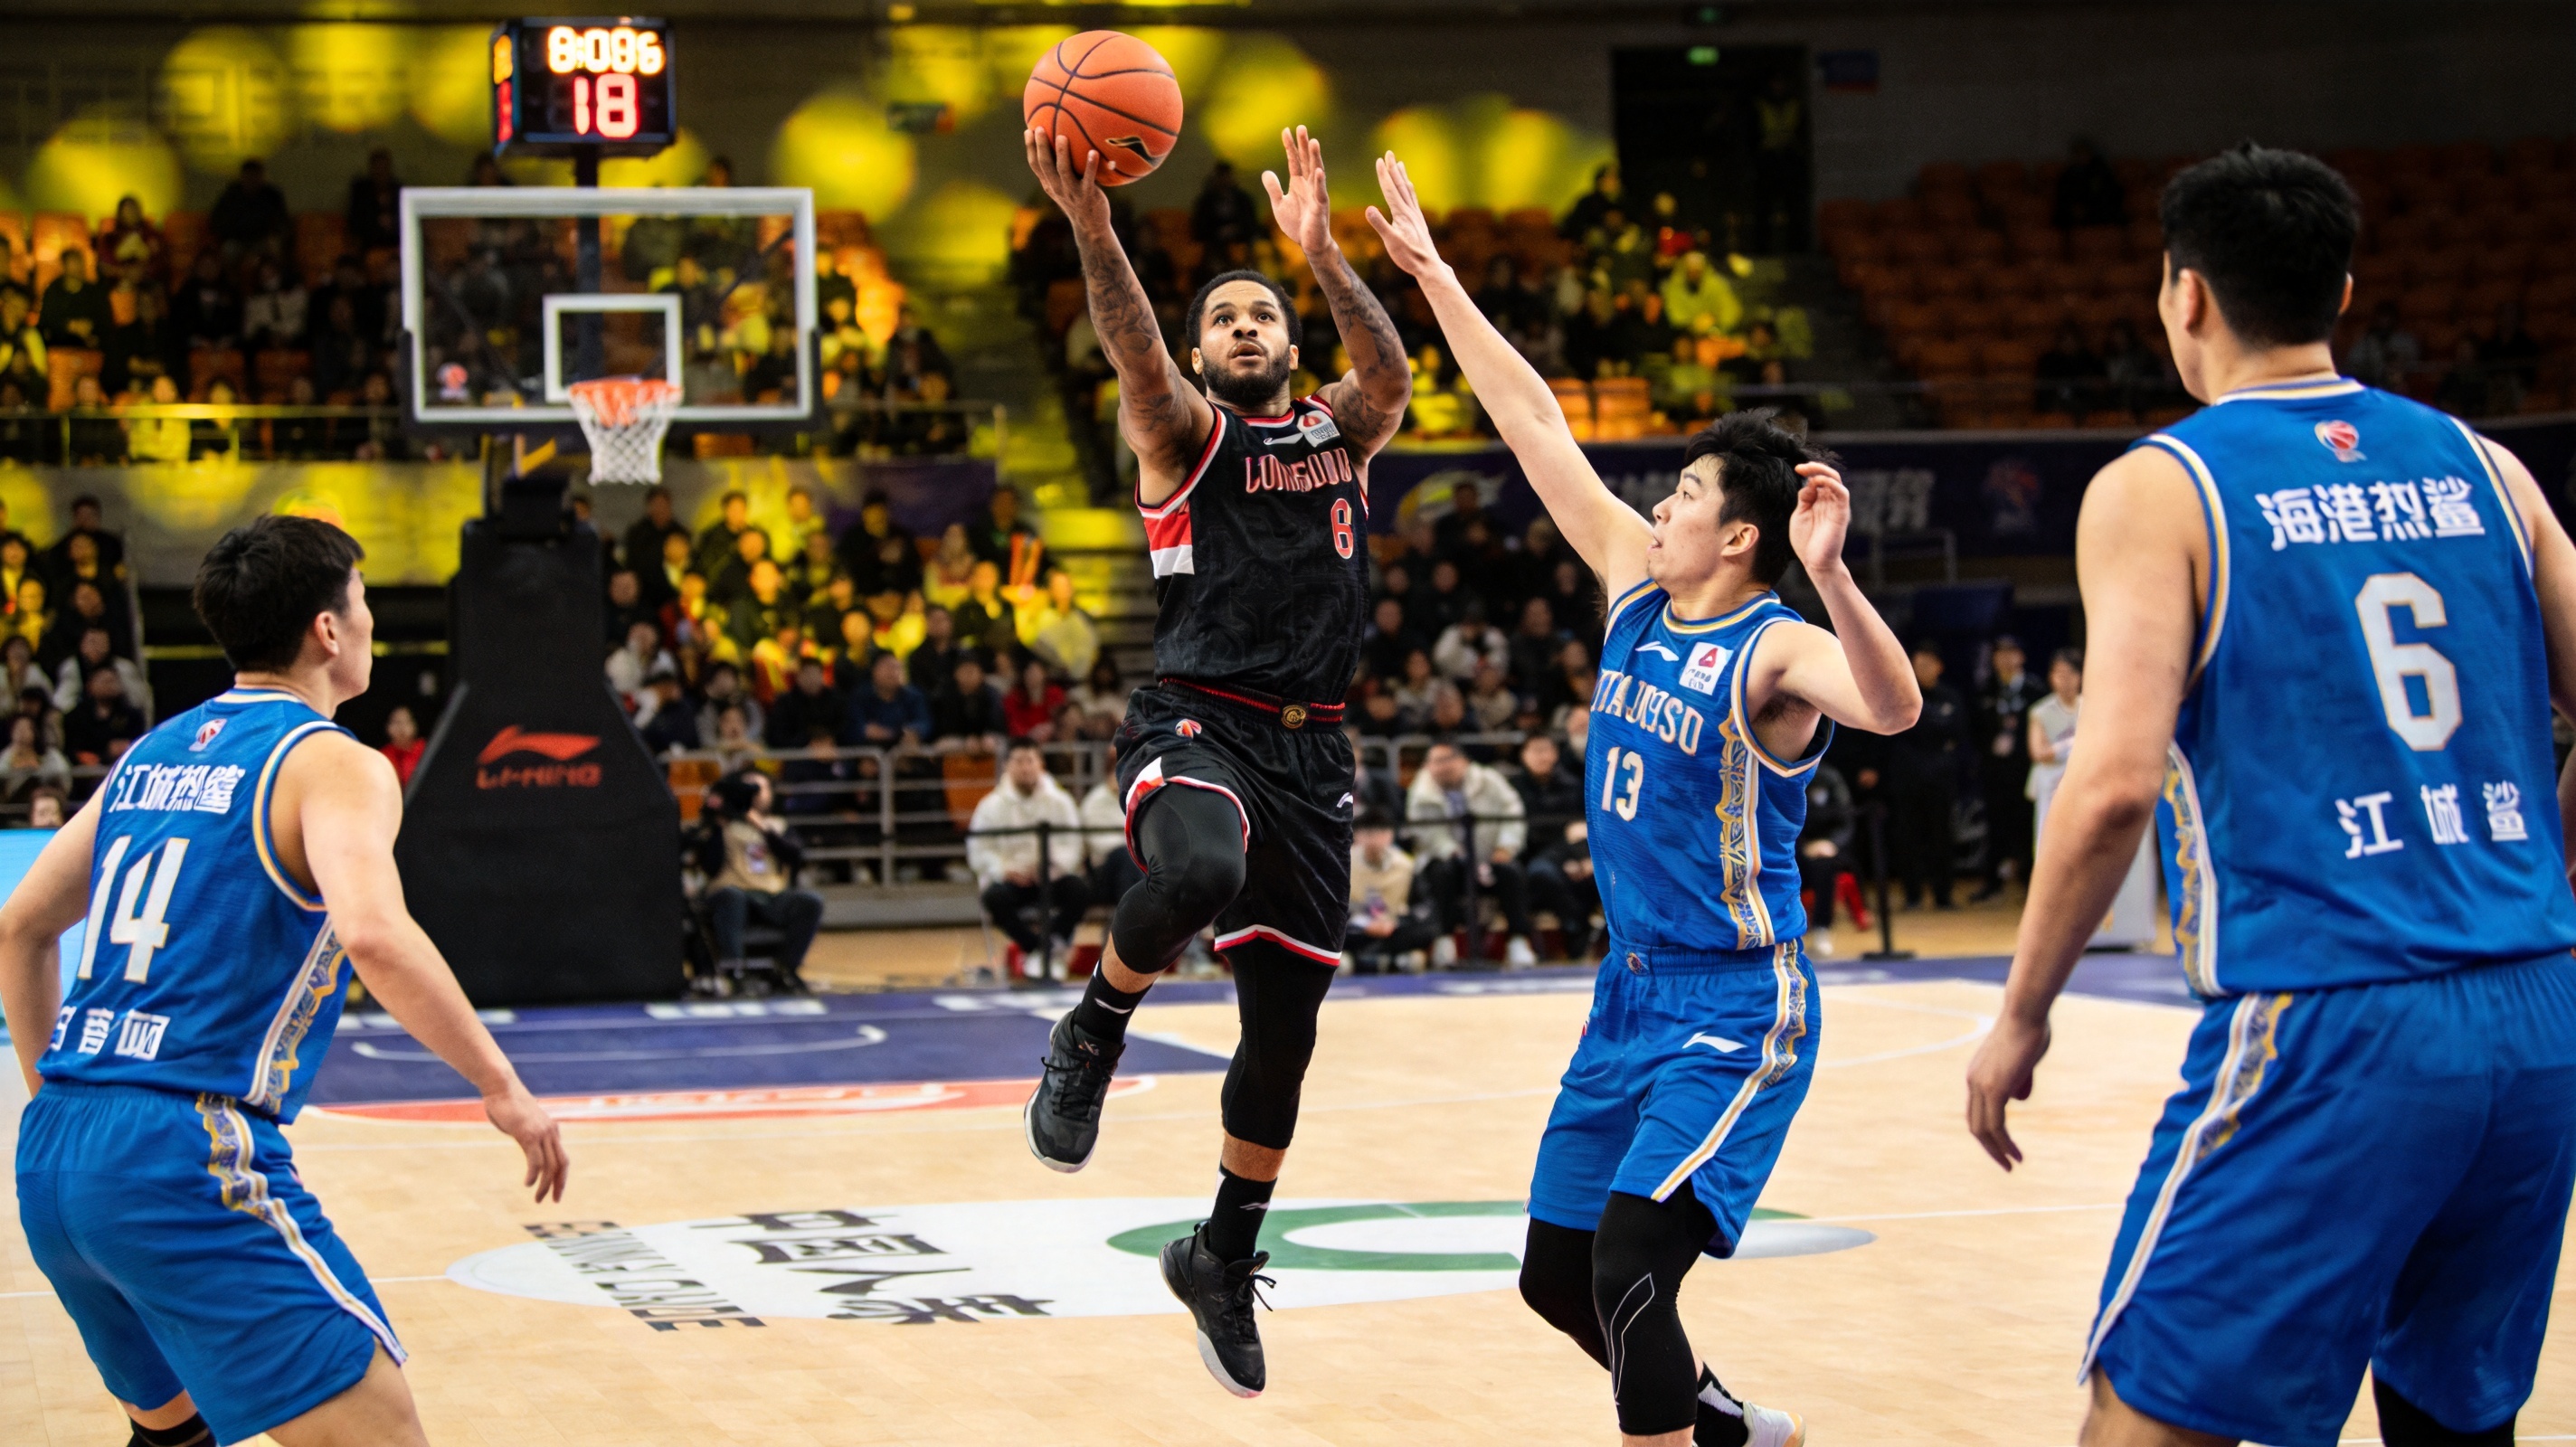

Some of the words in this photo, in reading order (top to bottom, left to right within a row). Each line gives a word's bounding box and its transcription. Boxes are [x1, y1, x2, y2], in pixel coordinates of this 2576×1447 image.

[573, 73, 639, 137] 18
[2354, 572, 2464, 751] 6
[1601, 747, 1643, 821] 13
[78, 835, 190, 984] 14
